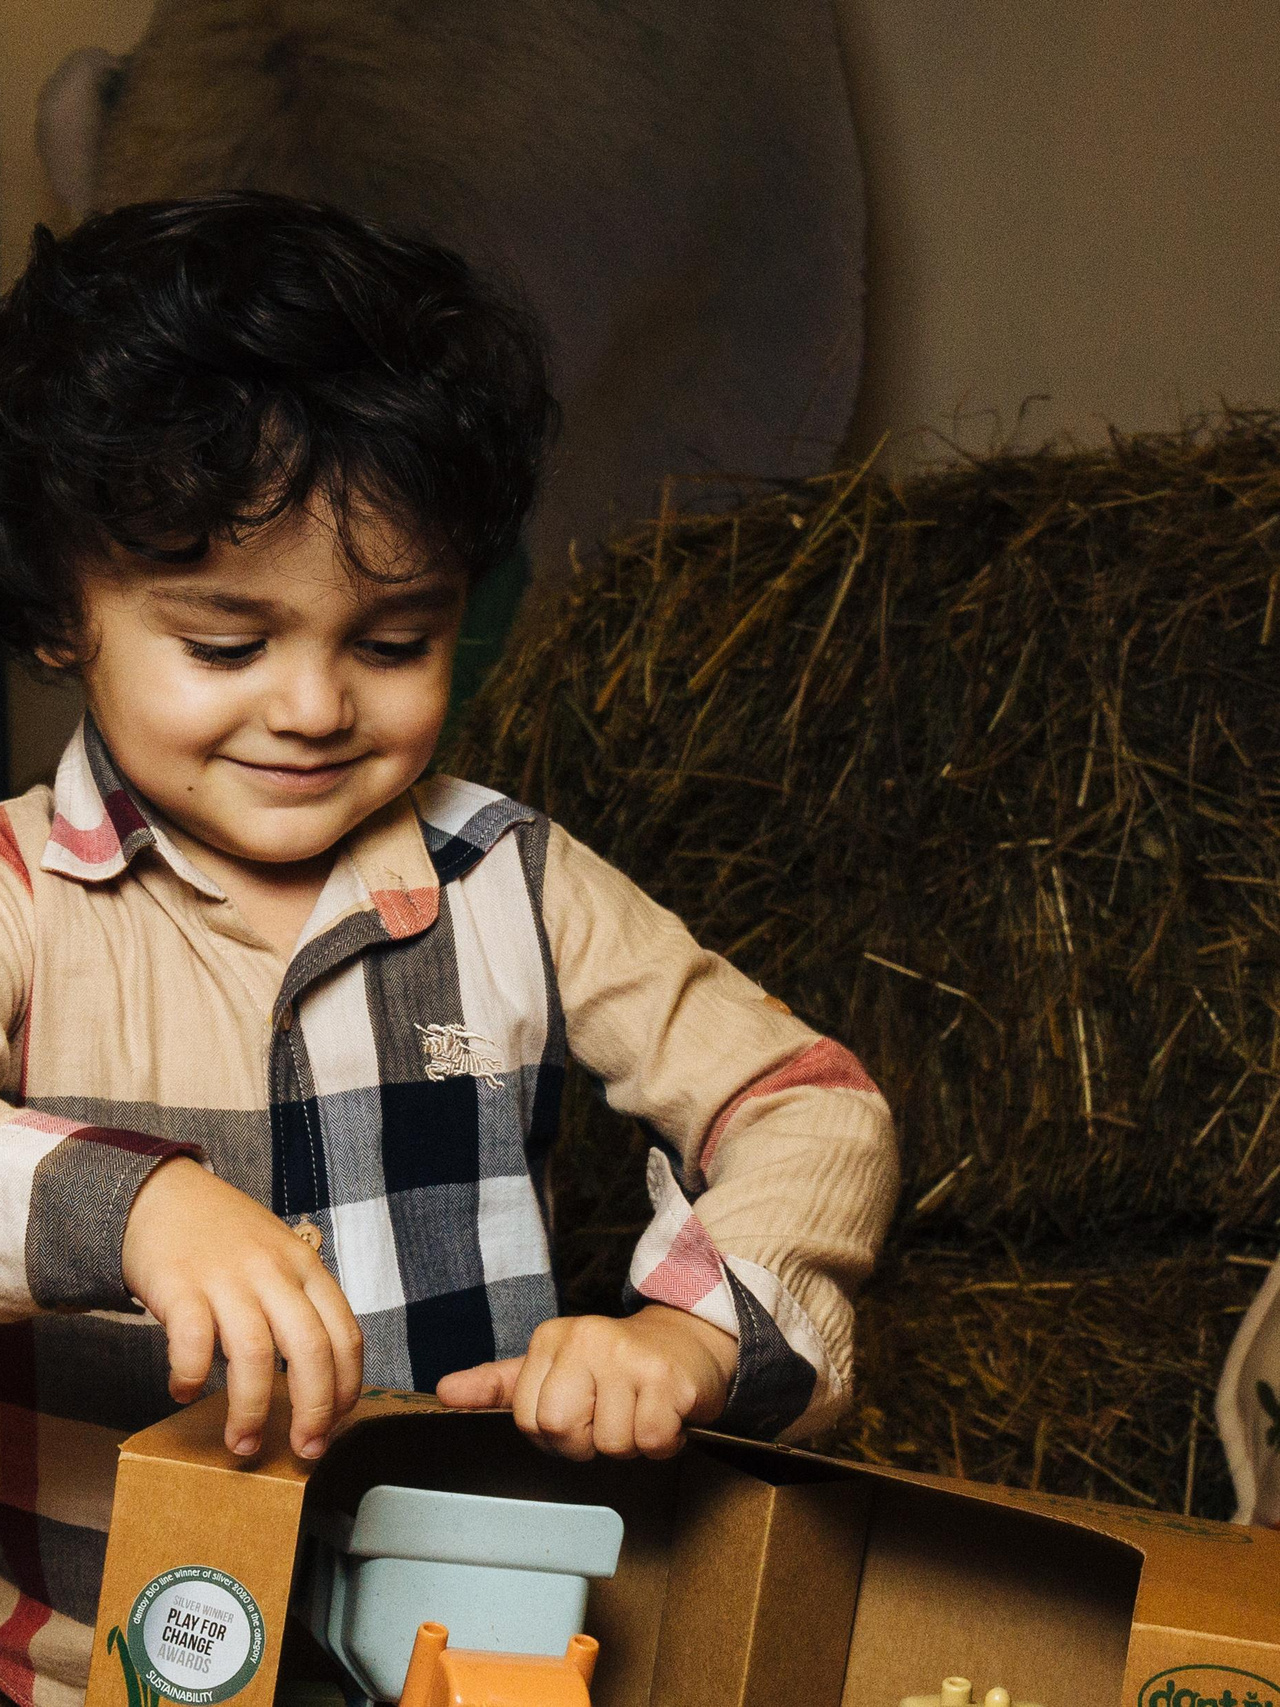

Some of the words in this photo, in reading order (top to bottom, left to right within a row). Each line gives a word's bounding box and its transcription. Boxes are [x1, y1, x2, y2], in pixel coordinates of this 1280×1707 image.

[158, 1574, 174, 1586] line
[174, 1569, 201, 1579] winner
[202, 1569, 212, 1578] of
[212, 1572, 233, 1587] silver
[145, 1582, 160, 1598] BIO
[231, 1583, 251, 1604] 2020
[132, 1597, 150, 1625] dantoy
[172, 1595, 202, 1613] SILVER
[201, 1604, 235, 1623] WINNER
[246, 1603, 255, 1613] in
[166, 1607, 201, 1632] PLAY
[200, 1619, 227, 1641] FOR
[250, 1612, 260, 1627] the
[162, 1625, 215, 1656] CHANGE
[250, 1627, 262, 1664] category
[156, 1644, 212, 1674] AWARDS
[145, 1670, 214, 1703] SUSTAINABILITY
